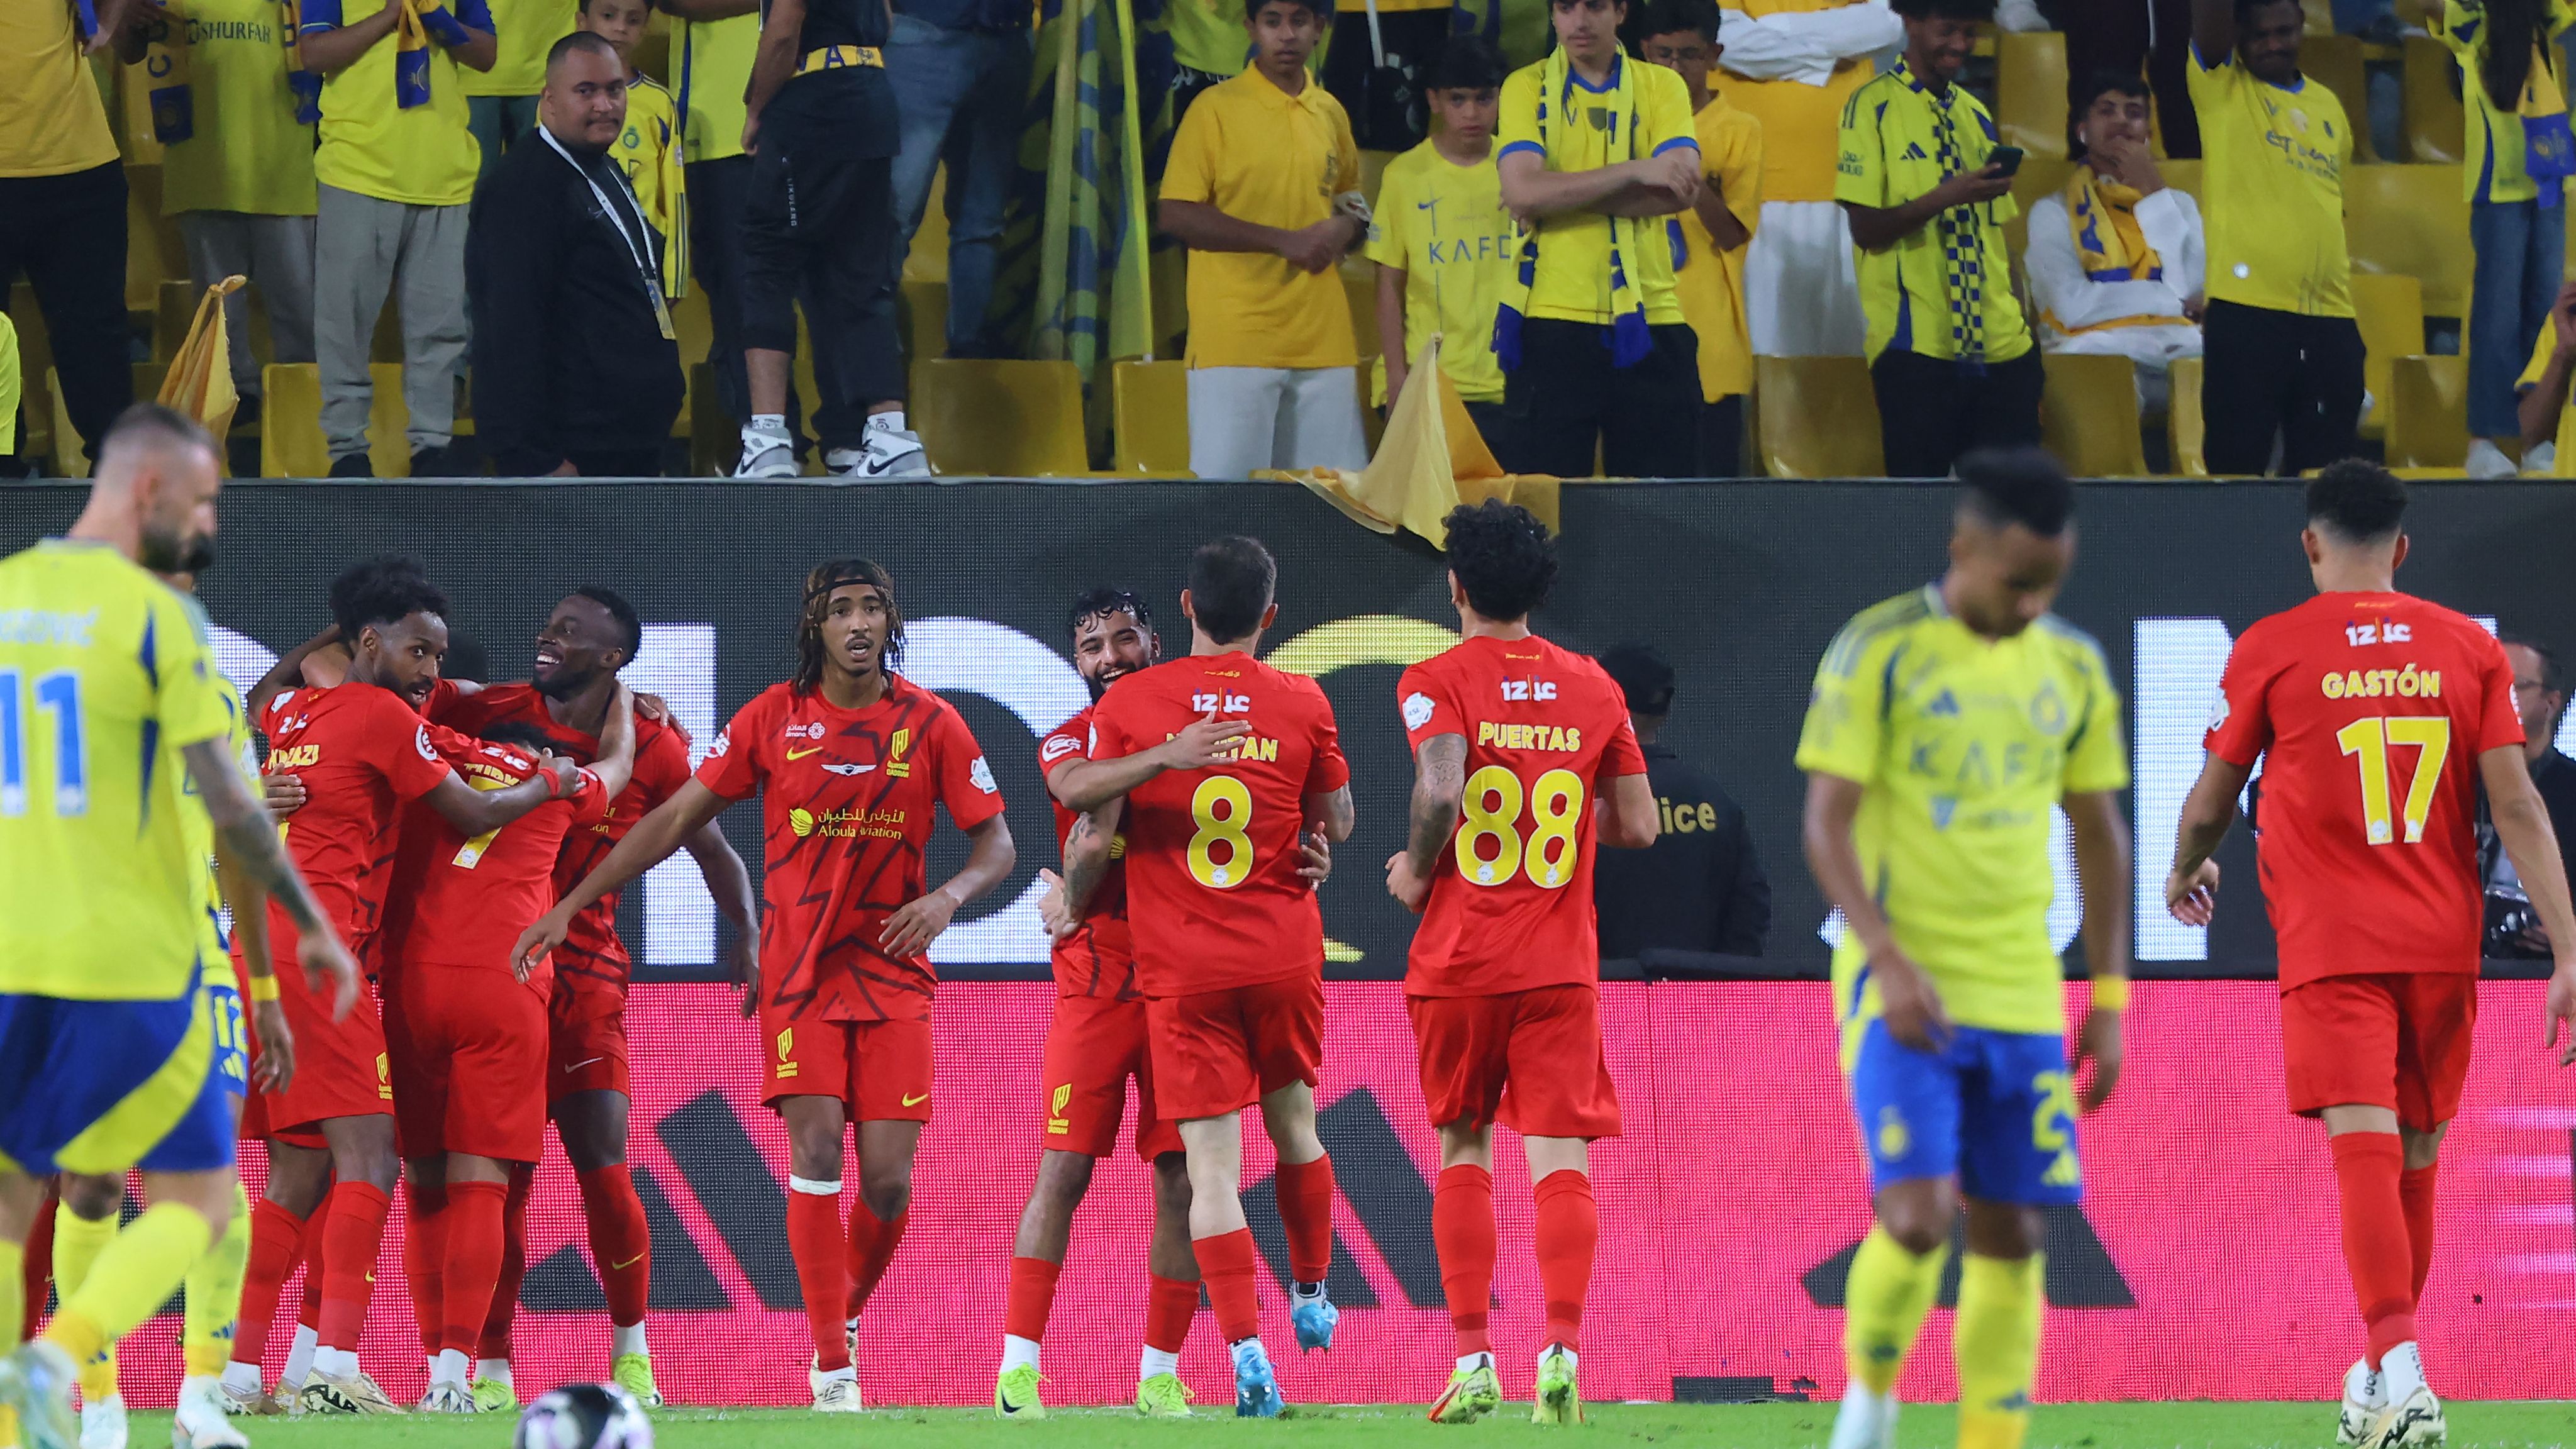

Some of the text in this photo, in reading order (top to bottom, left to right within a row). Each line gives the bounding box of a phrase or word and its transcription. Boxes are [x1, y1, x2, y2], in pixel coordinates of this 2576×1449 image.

[1478, 721, 1581, 752] PUERTAS
[2321, 662, 2441, 699] GASTÓN
[0, 669, 86, 814] 11
[2336, 716, 2450, 845] 17
[818, 825, 856, 837] Aloula
[1187, 775, 1253, 887] 8
[1455, 765, 1584, 889] 88
